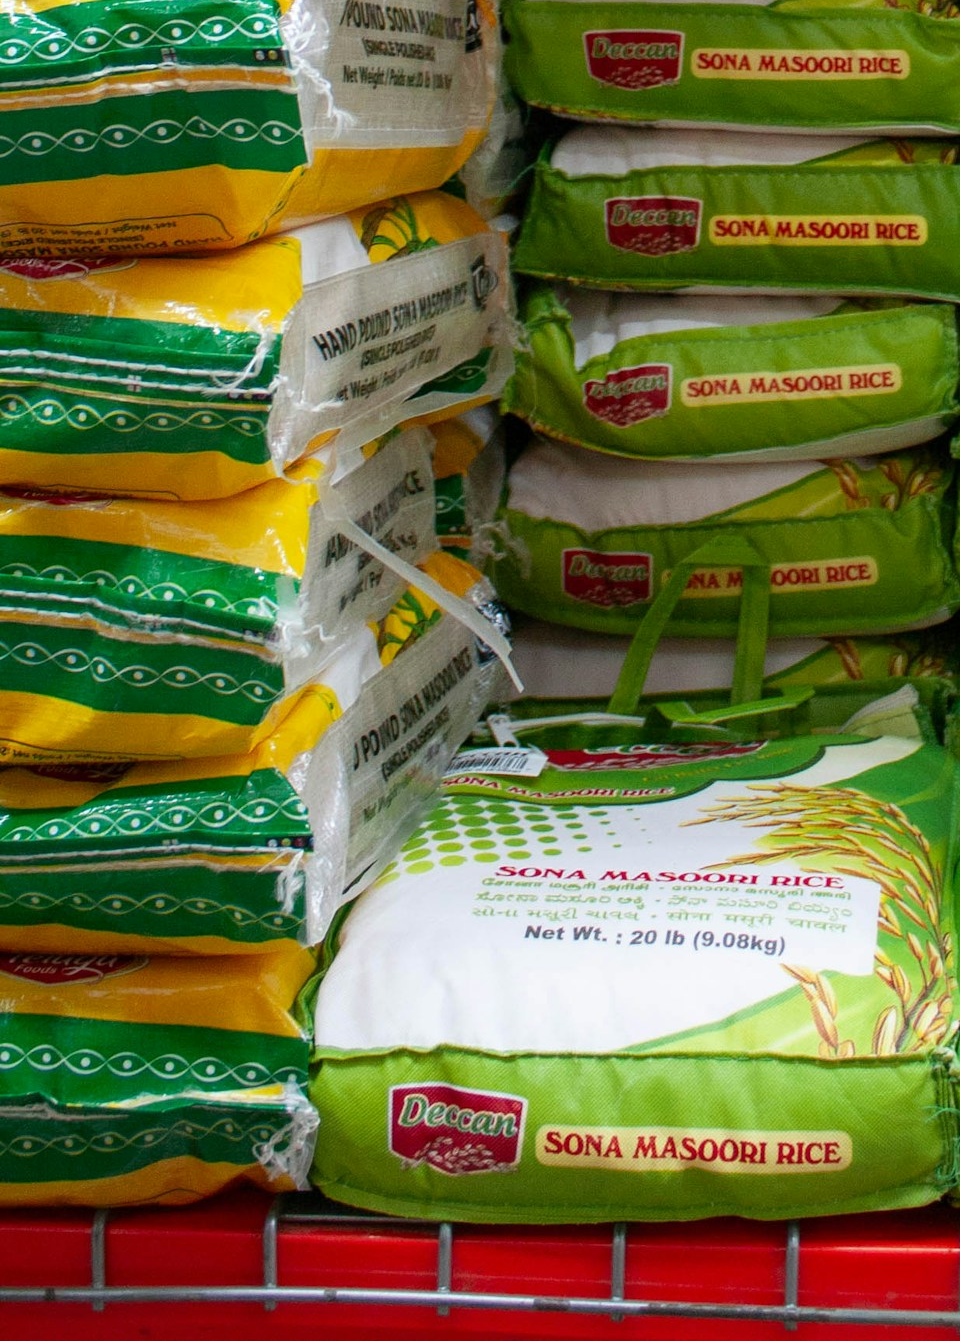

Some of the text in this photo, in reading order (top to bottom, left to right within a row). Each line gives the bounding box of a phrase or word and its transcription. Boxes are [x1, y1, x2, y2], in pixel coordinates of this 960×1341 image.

[592, 37, 678, 59] Deccan
[697, 53, 903, 74] SONA MASOORI RICE
[611, 204, 696, 226] Deccan
[715, 220, 920, 241] SONA MASOORI RICE
[495, 866, 845, 889] SONA MASOORI RICE
[524, 925, 565, 940] Net
[573, 926, 608, 942] Wt.
[630, 930, 657, 945] 20
[665, 930, 685, 946] lb
[693, 931, 786, 956] (9.08kg)
[399, 1093, 518, 1137] Deccan
[543, 1131, 842, 1165] SONA MASOORI RICE
